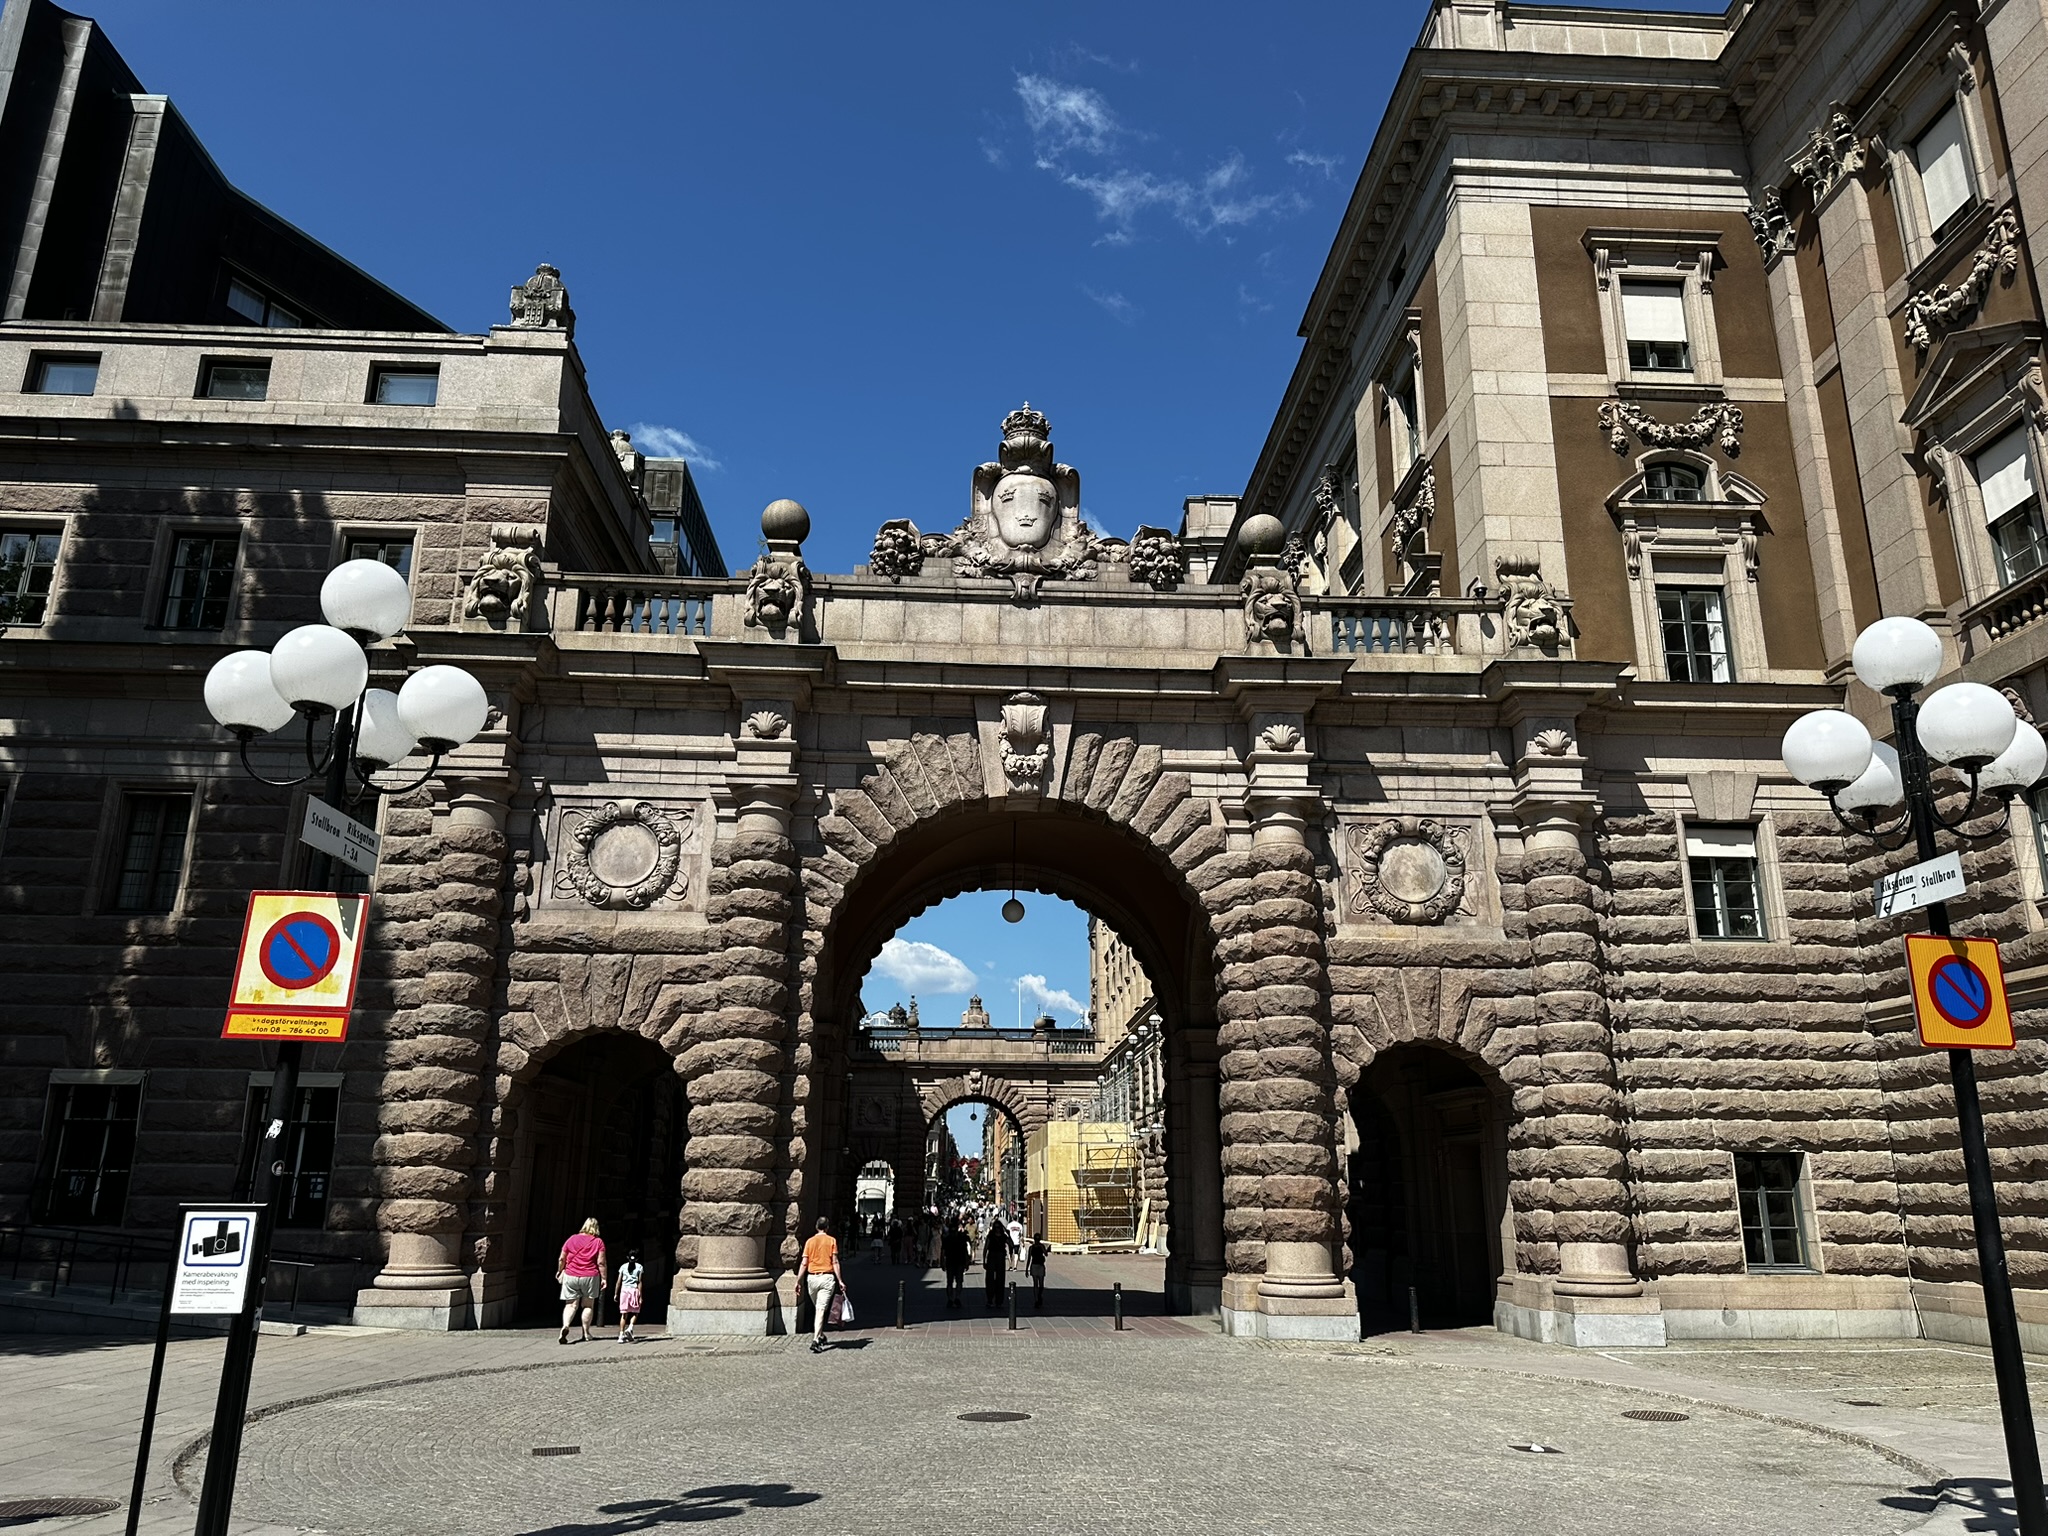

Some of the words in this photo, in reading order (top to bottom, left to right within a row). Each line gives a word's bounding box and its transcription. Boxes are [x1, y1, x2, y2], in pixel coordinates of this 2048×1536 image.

[311, 812, 340, 838] Stallbron
[346, 822, 375, 848] Riksgatan
[343, 844, 358, 863] 1-3A
[1880, 874, 1914, 894] Riksgatan
[1921, 870, 1957, 888] Stallbron
[1912, 894, 1917, 905] 2
[183, 1271, 238, 1279] Kamerabevakning
